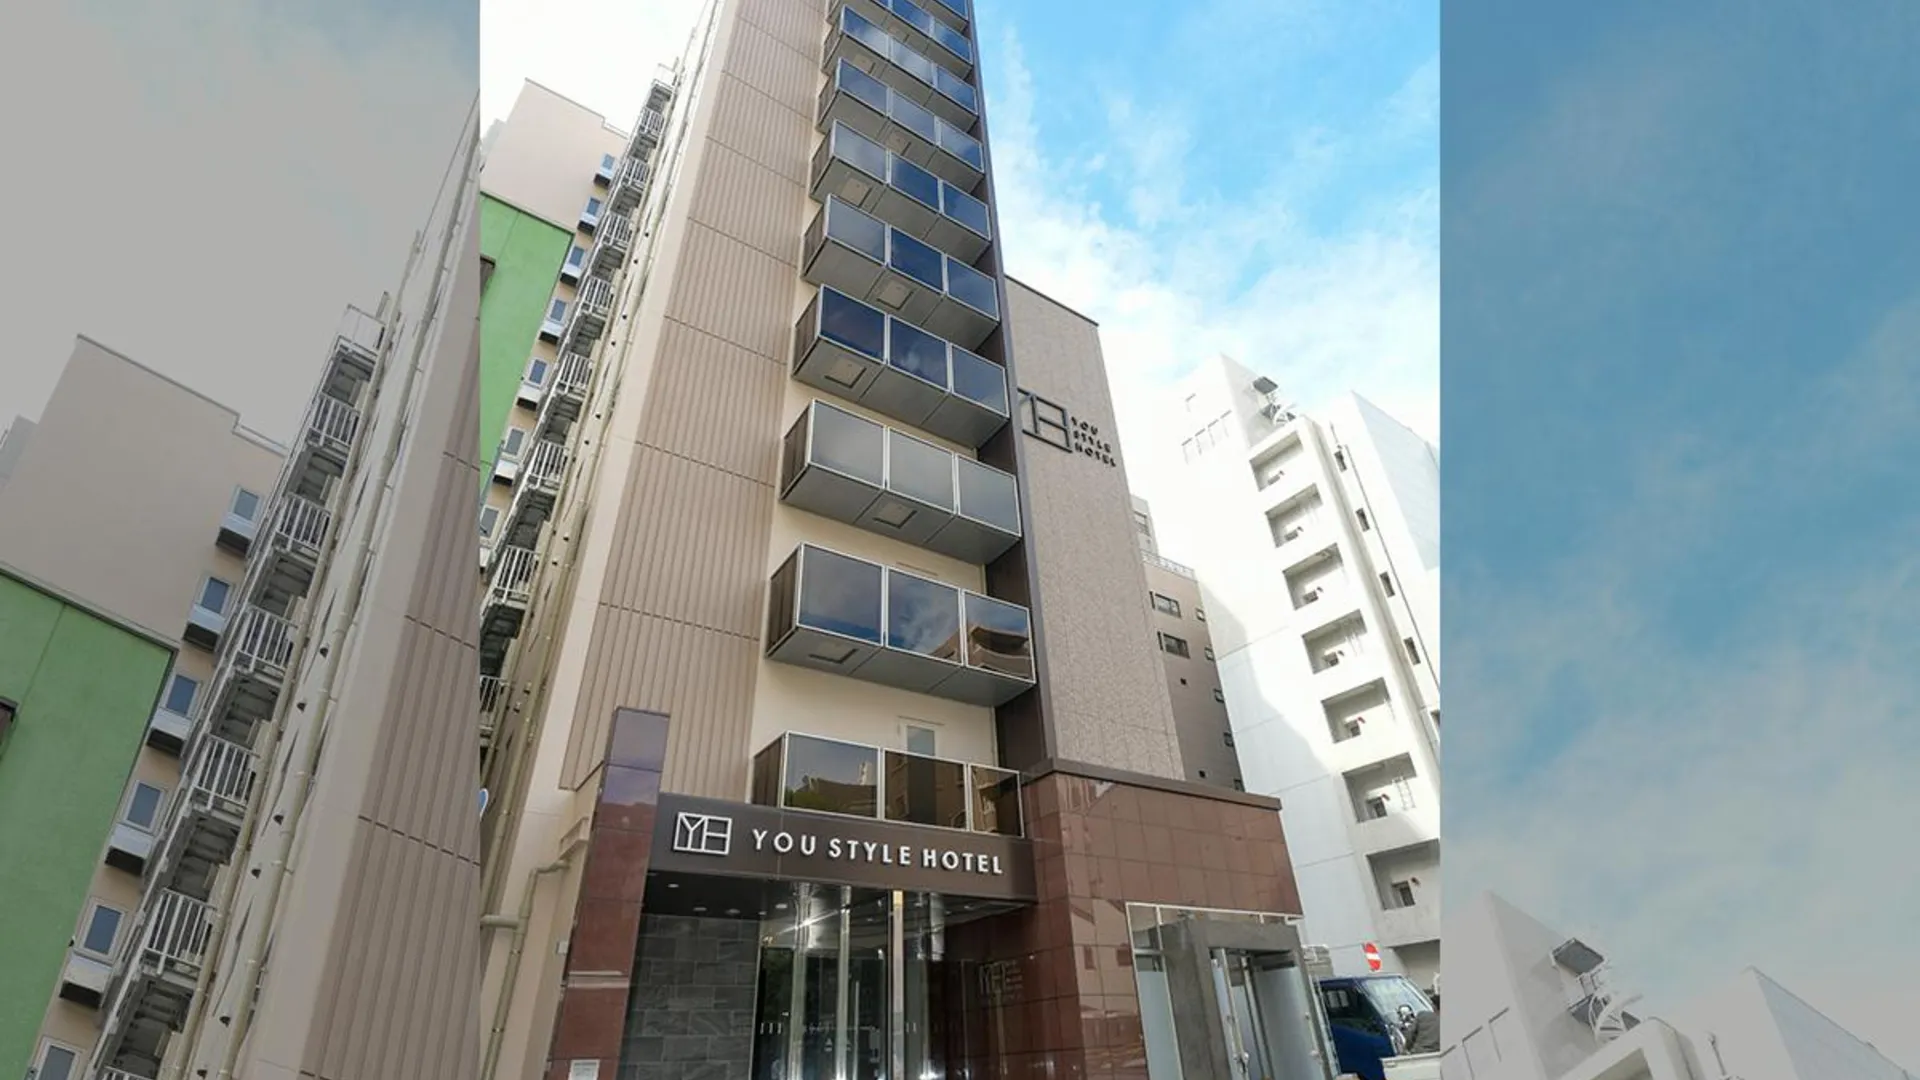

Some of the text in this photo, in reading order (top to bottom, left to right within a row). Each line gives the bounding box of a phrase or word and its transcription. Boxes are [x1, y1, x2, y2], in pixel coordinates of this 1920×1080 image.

[1074, 442, 1117, 468] HOTEL
[752, 828, 816, 856] YOU
[828, 838, 911, 866] STYLE
[922, 848, 1003, 874] HOTEL
